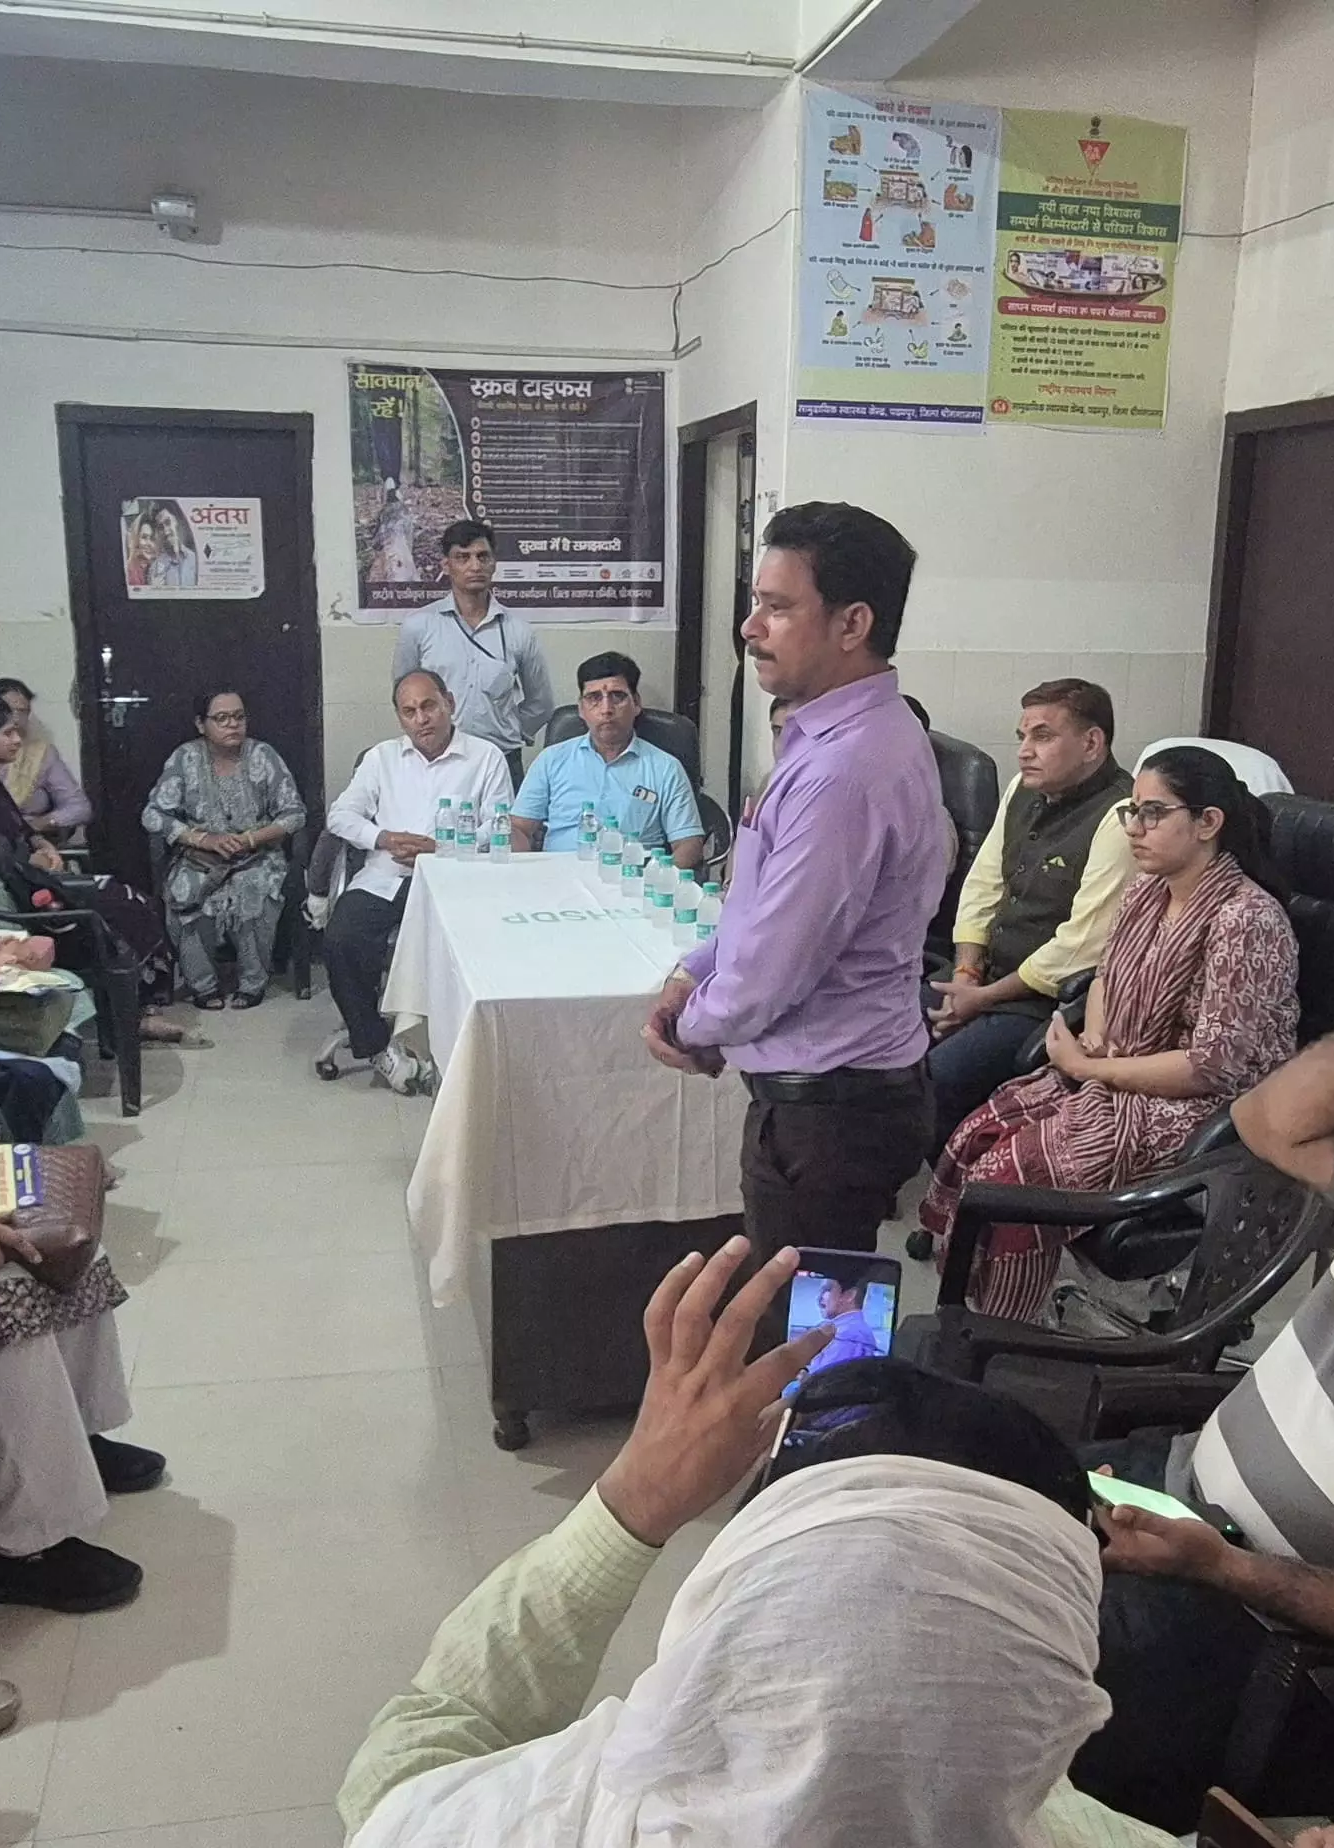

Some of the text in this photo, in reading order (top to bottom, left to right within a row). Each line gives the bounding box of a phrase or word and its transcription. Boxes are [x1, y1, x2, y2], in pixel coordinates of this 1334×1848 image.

[1103, 220, 1134, 235] परिवार
[354, 370, 593, 399] सावधान स्क्रब टाइफस
[189, 503, 251, 525] अंतरा
